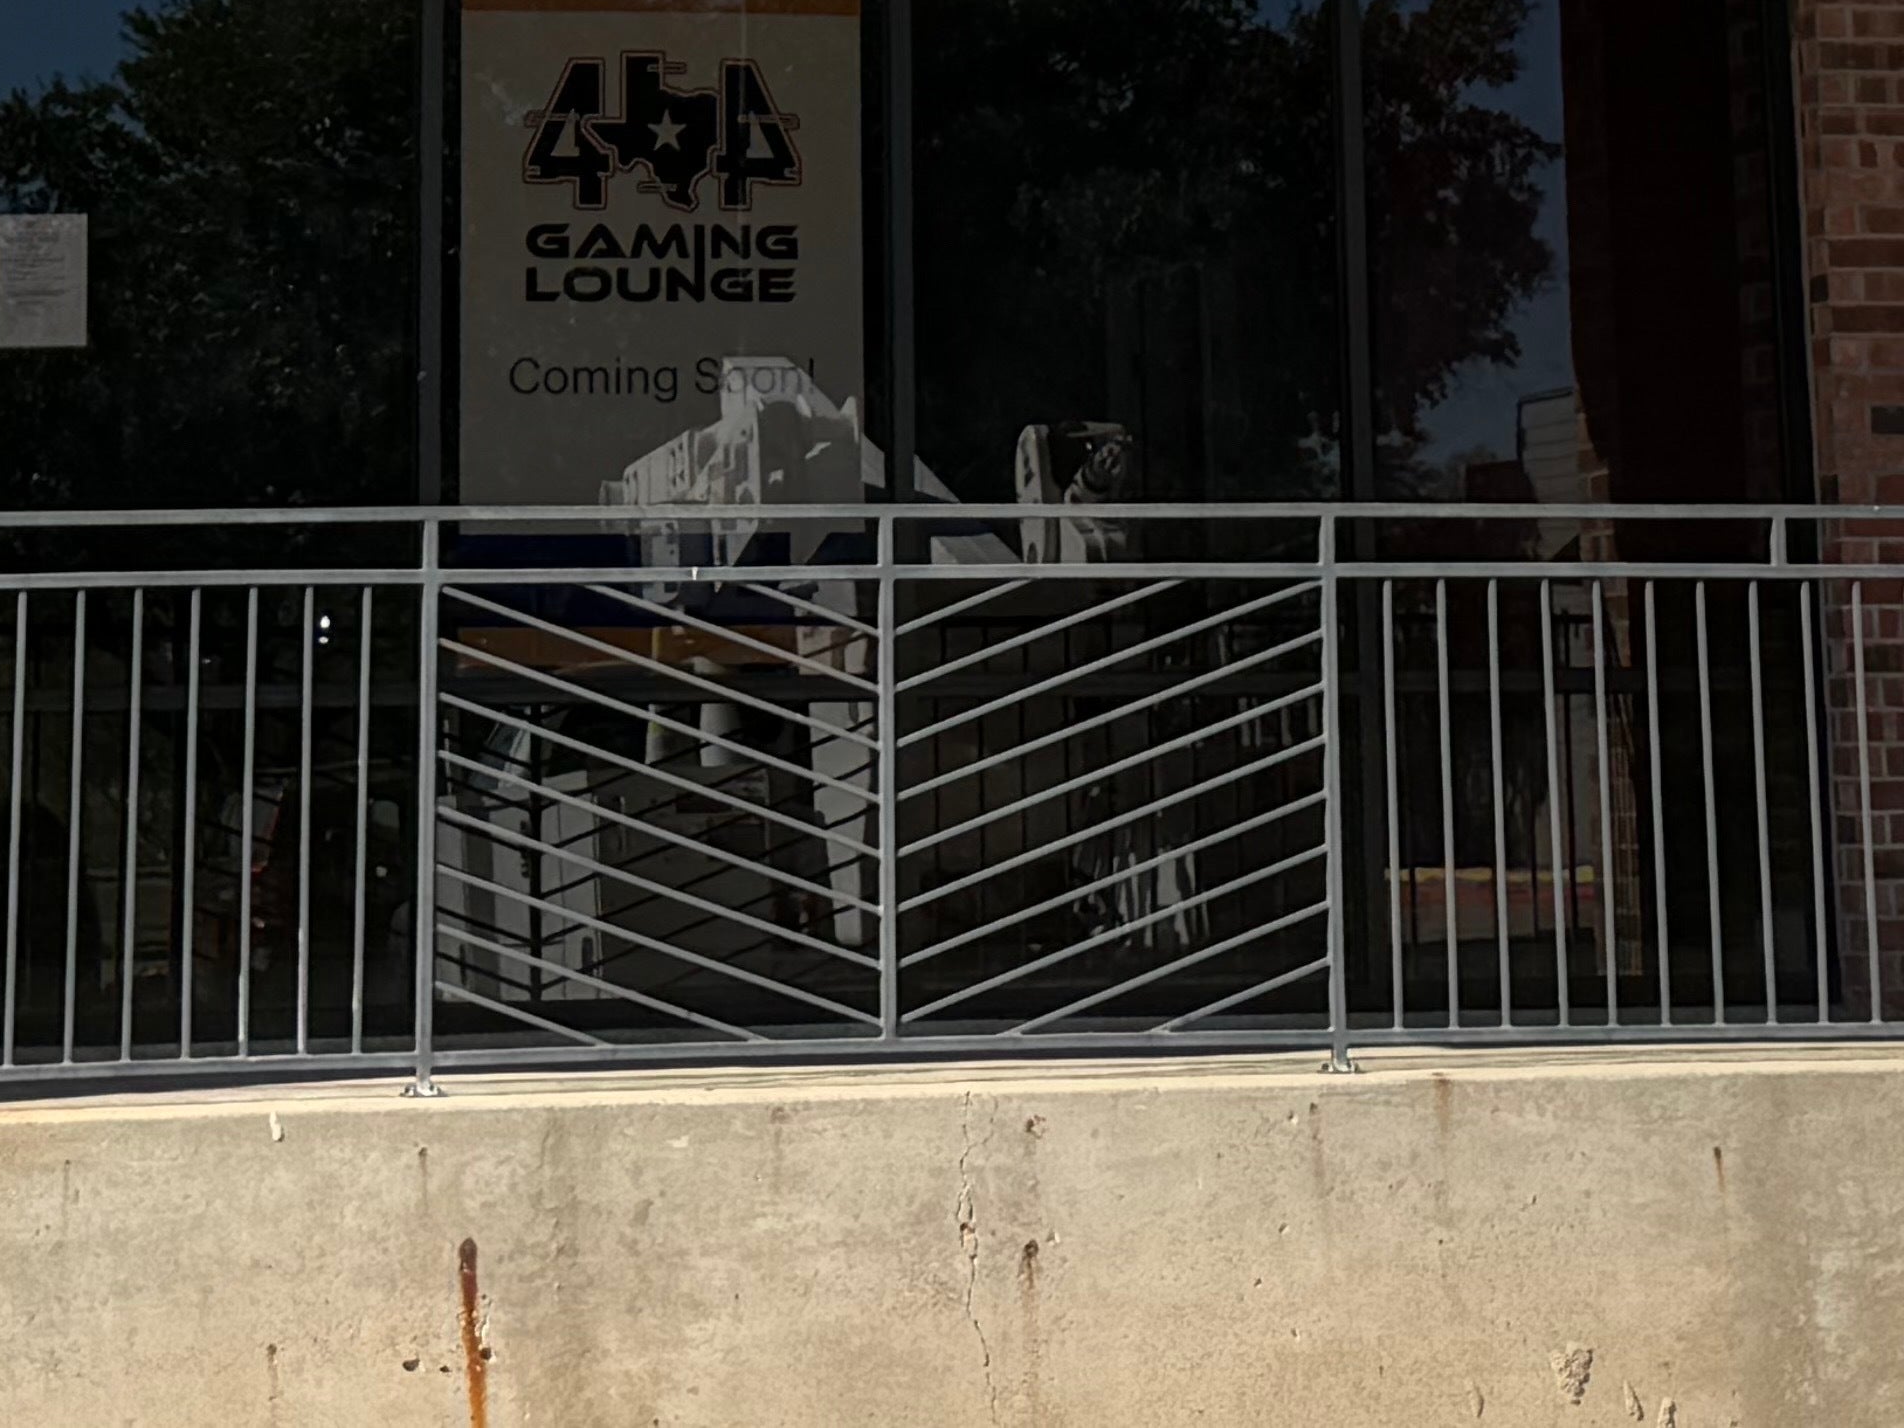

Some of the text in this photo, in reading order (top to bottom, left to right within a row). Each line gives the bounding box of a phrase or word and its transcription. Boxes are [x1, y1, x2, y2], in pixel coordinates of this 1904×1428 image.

[525, 223, 799, 260] GAMING
[525, 266, 796, 303] LOUNGE
[509, 356, 815, 404] Coming Soon!
